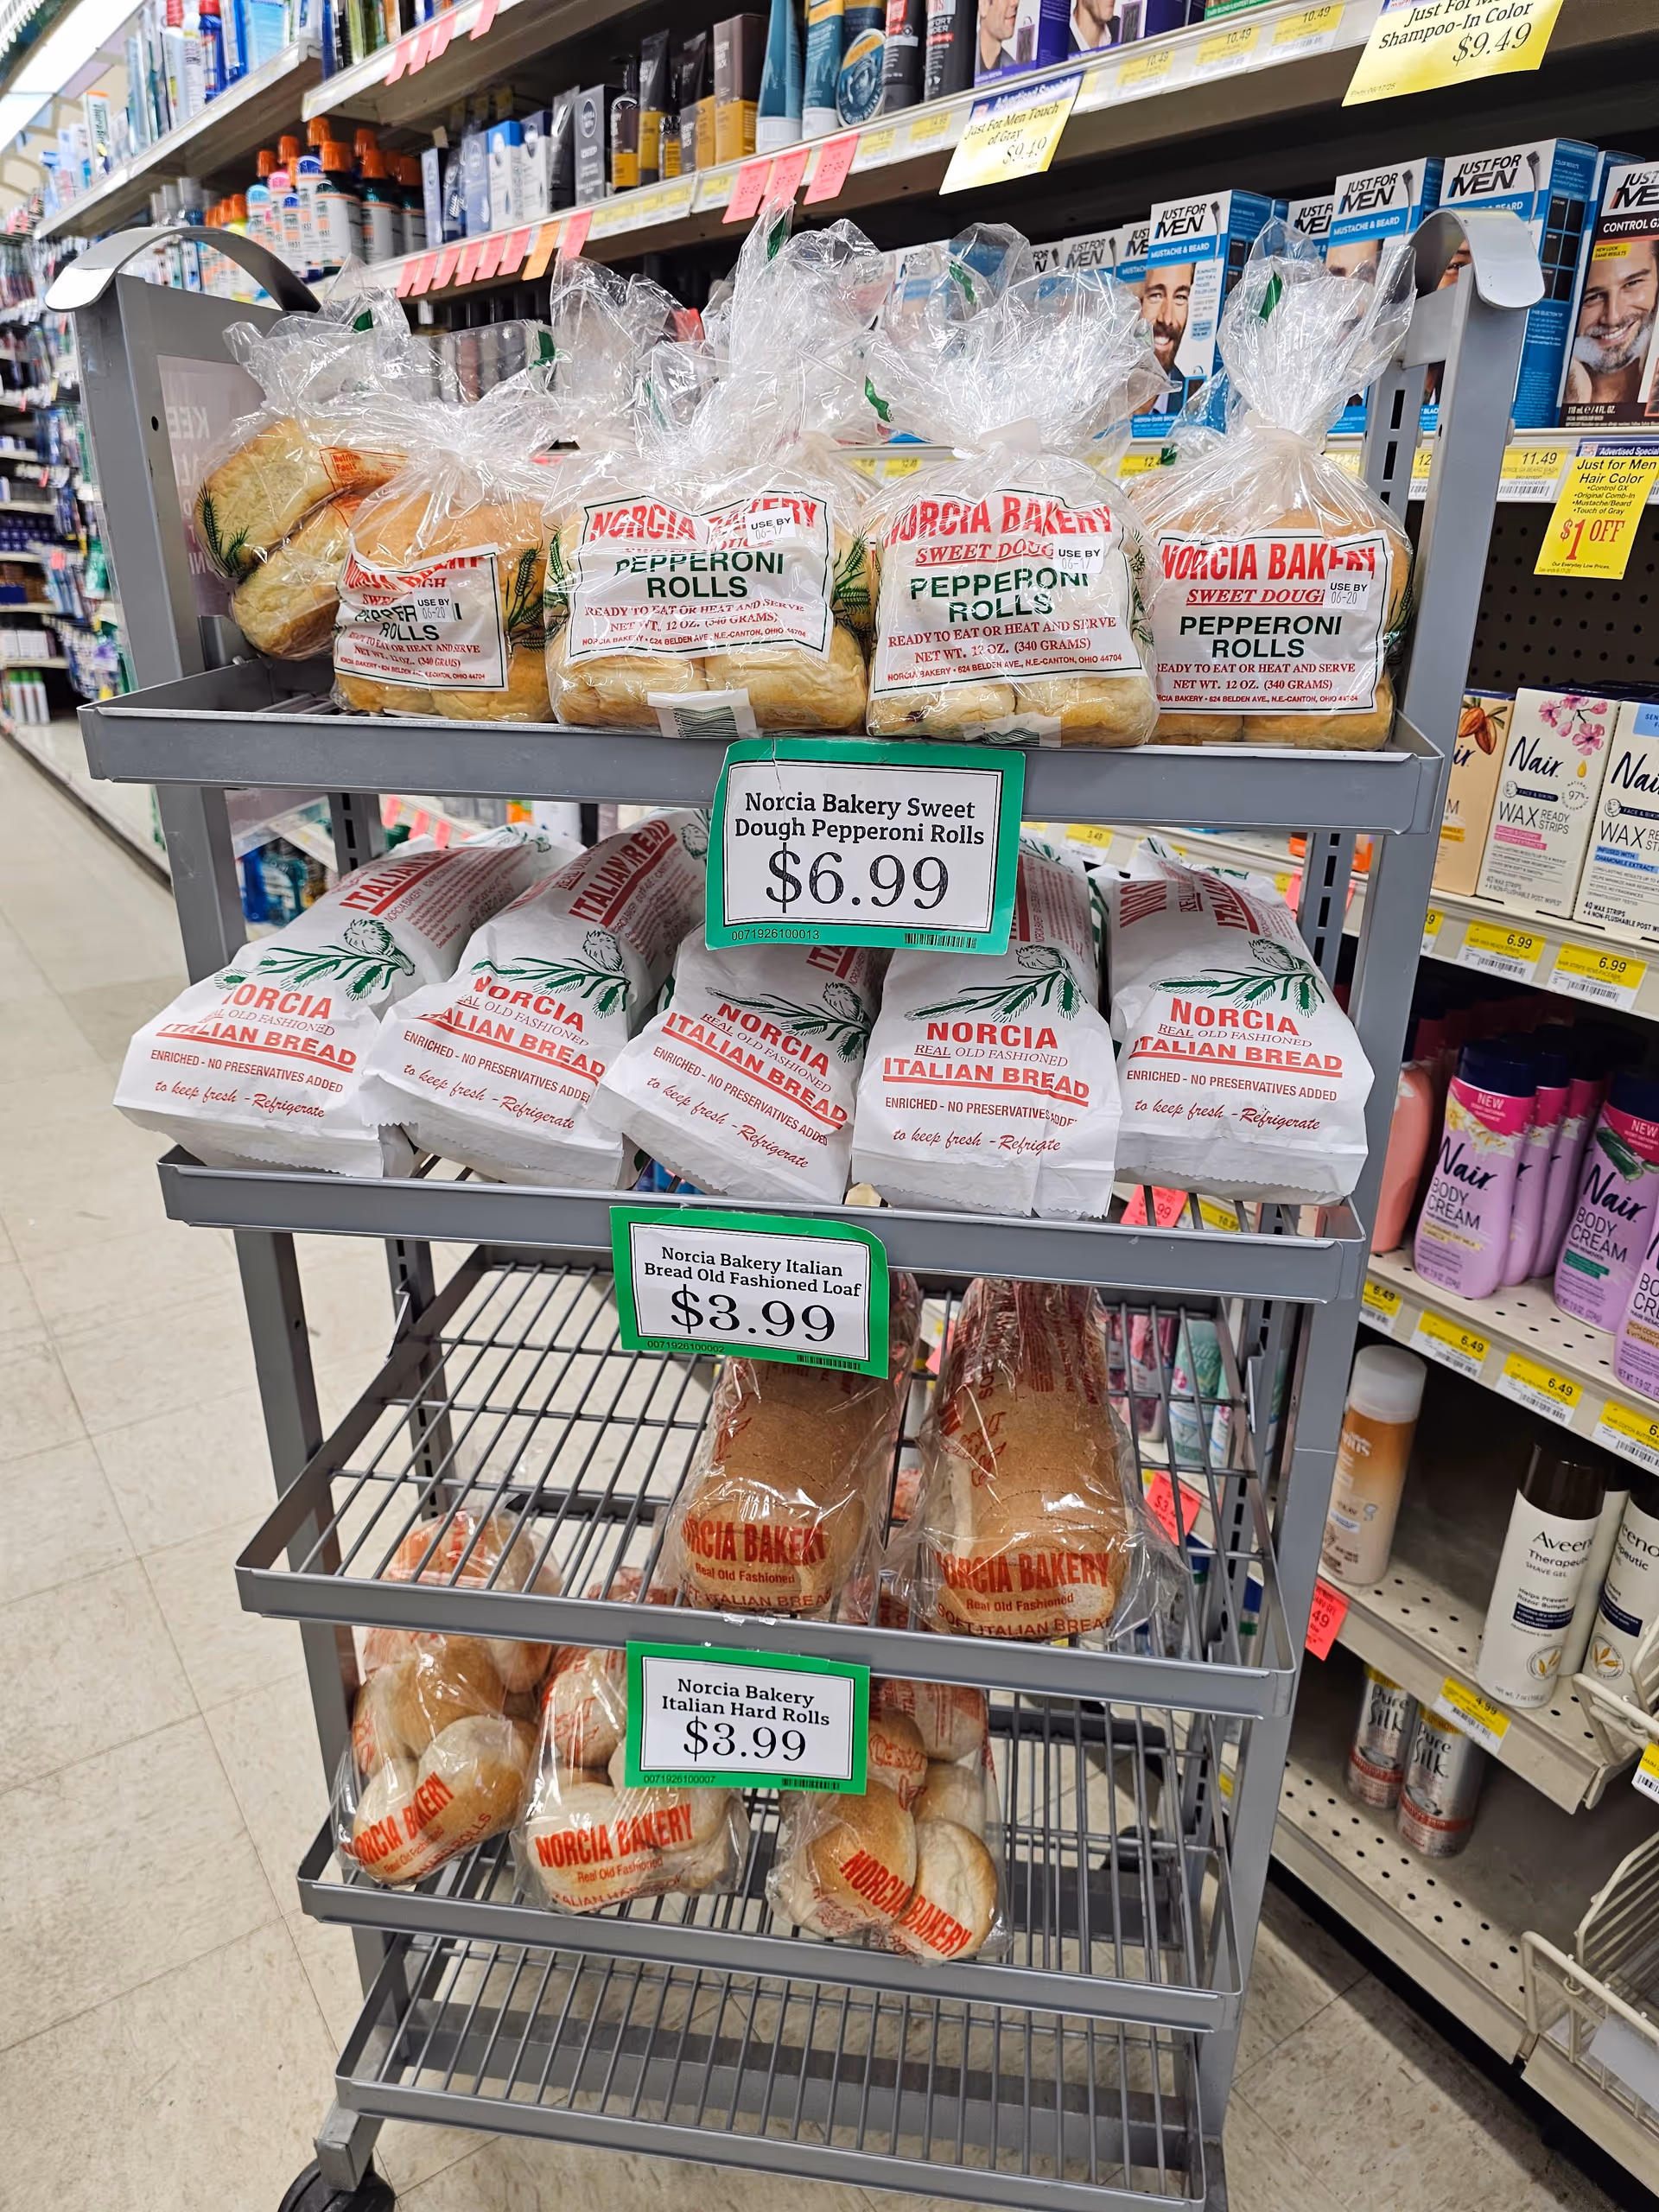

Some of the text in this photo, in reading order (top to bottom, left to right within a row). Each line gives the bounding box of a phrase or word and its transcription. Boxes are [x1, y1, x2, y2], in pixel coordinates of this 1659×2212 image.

[1303, 6, 1330, 24] 10.49
[1379, 3, 1534, 49] Shampoo-In Color
[1404, 5, 1440, 28] Just
[1225, 29, 1252, 45] 10.49
[1452, 22, 1532, 67] $9.49
[1146, 50, 1170, 66] 10.49
[964, 102, 1058, 139] Just For Men Touch
[988, 129, 1023, 145] of Gray
[1458, 154, 1522, 177] JUST FOR
[1346, 174, 1398, 196] JUST FOR
[1447, 168, 1519, 198] MEN
[1338, 187, 1395, 214] MEN
[1162, 203, 1206, 222] JUST FOR
[1154, 218, 1204, 239] MEN
[1333, 222, 1369, 235] MUSTACHE
[1376, 217, 1400, 227] BEARD
[1603, 219, 1647, 232] CONTROL
[1151, 248, 1182, 258] MUSTACHE
[1188, 242, 1210, 252] BEARD
[1522, 452, 1557, 465] 11.49
[1599, 447, 1633, 455] Advertised
[1577, 460, 1656, 470] Just for Men
[1580, 474, 1643, 484] Hair Color
[1560, 518, 1625, 561] $1 OFF
[614, 551, 784, 576] PEPPERONI
[1058, 550, 1082, 558] USE
[1163, 544, 1256, 580] NORCIA
[647, 577, 747, 598] ROLLS
[1186, 589, 1257, 602] SWEET
[1330, 582, 1351, 591] USE
[1331, 593, 1357, 604] 06-20
[1180, 616, 1342, 635] PEPPERONI
[1212, 639, 1305, 658] ROLLS
[1157, 664, 1355, 673] READY TO EAT OR HEAT AND SERVE
[1173, 680, 1196, 689] NET
[1199, 680, 1221, 689] WT.
[1240, 680, 1259, 689] OZ.
[1264, 680, 1284, 690] (340
[1287, 679, 1332, 690] GRAMS)
[1509, 736, 1564, 778] Nair
[745, 793, 976, 819] Norcia Bakery Sweet
[1500, 801, 1570, 829] WAX READY
[735, 818, 984, 845] Dough Pepperoni Rolls
[1539, 821, 1569, 834] STRIPS
[1600, 821, 1647, 849] WAX
[766, 842, 949, 913] $6.99
[731, 929, 819, 941] 0071926100013
[1507, 934, 1533, 949] 6.99
[1599, 957, 1626, 972] 6.99
[1171, 998, 1300, 1036] NORCIA
[716, 1002, 831, 1077] NORCIA
[926, 1022, 1058, 1049] NORCIA
[1158, 1023, 1312, 1047] REAL OLD FASHIONED
[1130, 1037, 1343, 1071] ITALIAN BREAD
[663, 1012, 848, 1122] ITALIAN BREAD
[884, 1058, 1089, 1099] ITALIAN BREAD
[1127, 1070, 1337, 1101] ENRICHED NO PRESERVATIVES ADDED
[1135, 1099, 1147, 1111] to
[1152, 1101, 1183, 1117] keep
[1187, 1103, 1224, 1119] fresh
[1478, 1092, 1504, 1109] NEW
[1631, 1120, 1658, 1136] NEW
[1440, 1136, 1497, 1191] Nair
[1432, 1178, 1469, 1203] BODY
[1584, 1163, 1647, 1222] Nair
[1427, 1195, 1481, 1230] CREAM
[1576, 1207, 1618, 1236] BODY
[1571, 1224, 1627, 1262] CREAM
[661, 1247, 842, 1277] Norcia Bakery Italian
[645, 1263, 861, 1296] Bread Old Fashioned Loaf
[1373, 1285, 1395, 1301] 6.49
[671, 1283, 835, 1341] $3.99
[647, 1341, 724, 1353] 0071926100002
[1460, 1335, 1484, 1352] 6.49
[1548, 1378, 1573, 1396] 6.49
[1020, 1554, 1110, 1592] BAKERY
[1525, 1562, 1550, 1575] SHAVE
[677, 1678, 815, 1709] Norcia Bakery
[662, 1696, 830, 1726] Italian Hard Rolls
[1475, 1696, 1497, 1716] 4.99
[683, 1716, 806, 1762] $3.99
[1417, 1719, 1452, 1753] Pure
[1414, 1737, 1449, 1779] Silk
[644, 1775, 715, 1785] 0071926100007
[536, 1803, 693, 1869] NORCIA BAKERY
[839, 1849, 972, 1957] NORCIA BAKERY
